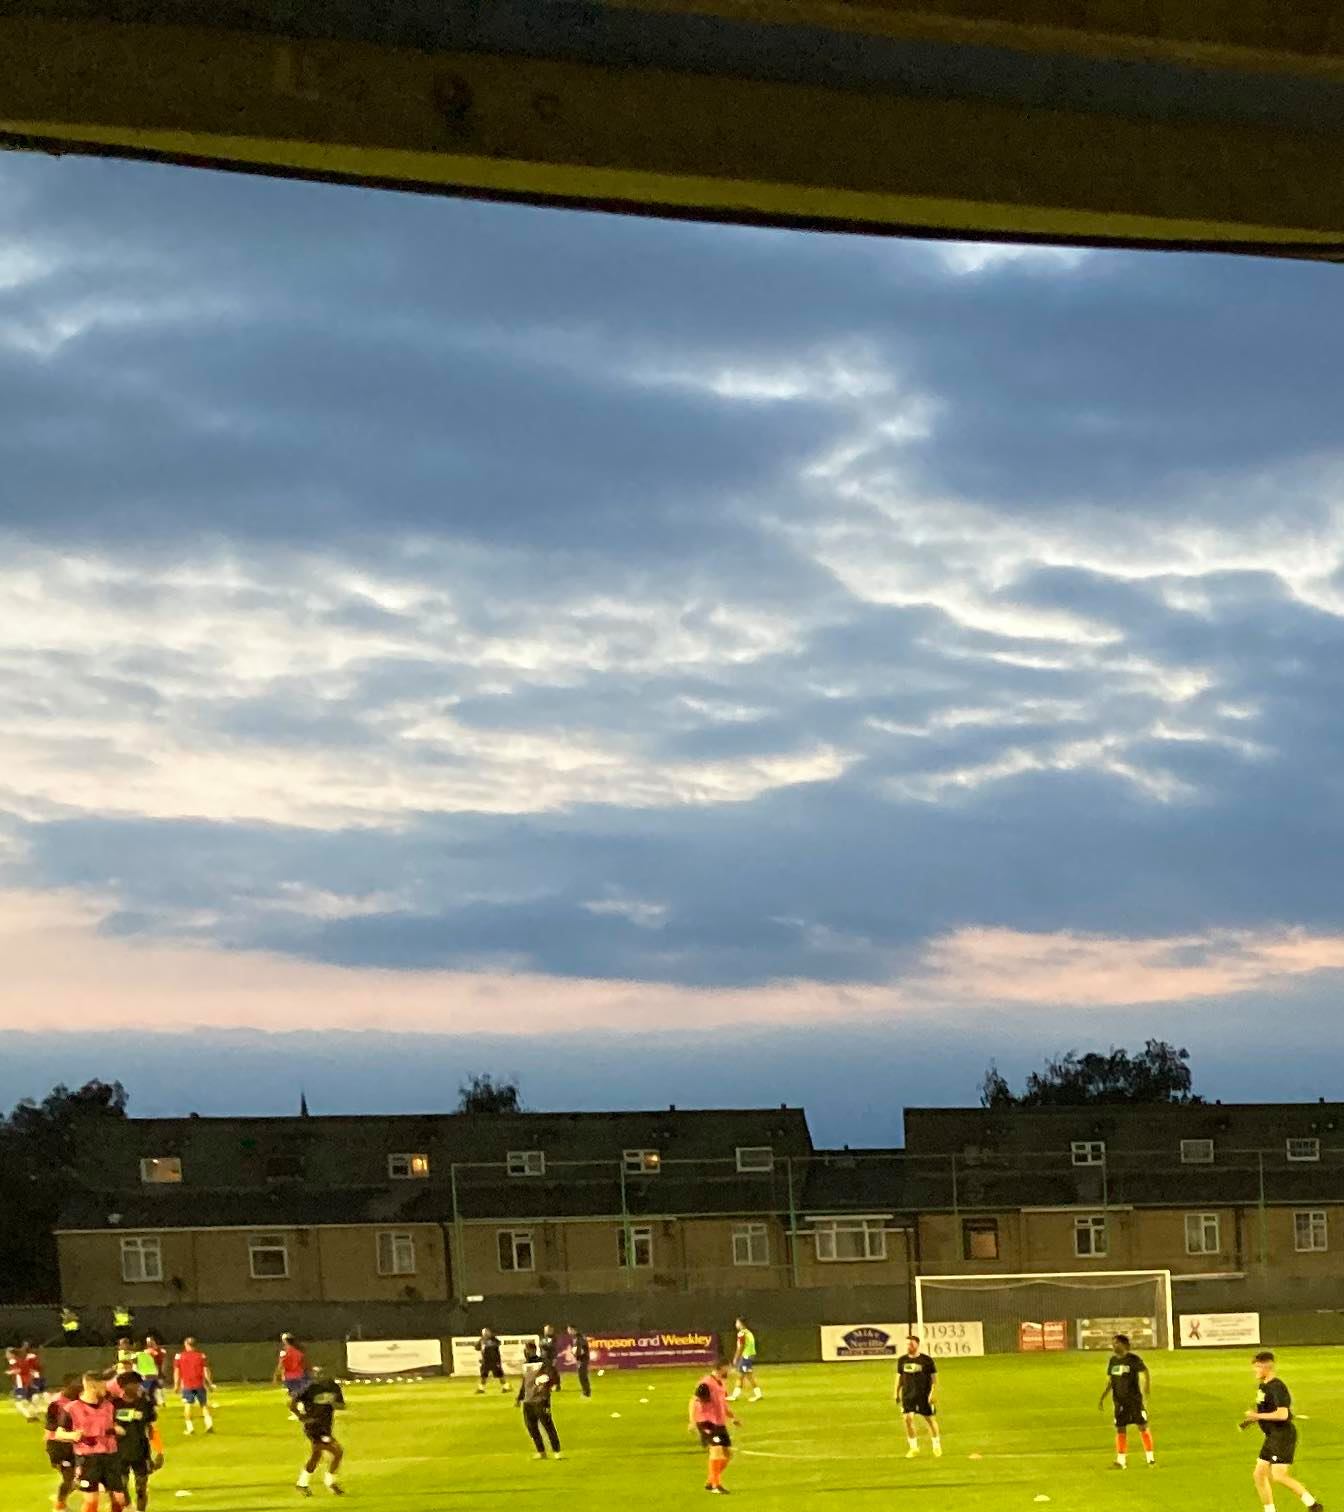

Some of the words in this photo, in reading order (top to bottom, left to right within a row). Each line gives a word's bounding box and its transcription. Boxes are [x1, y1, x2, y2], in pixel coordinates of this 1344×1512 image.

[854, 1330, 881, 1338] Mike
[638, 1335, 660, 1347] and
[660, 1333, 712, 1347] Weekley
